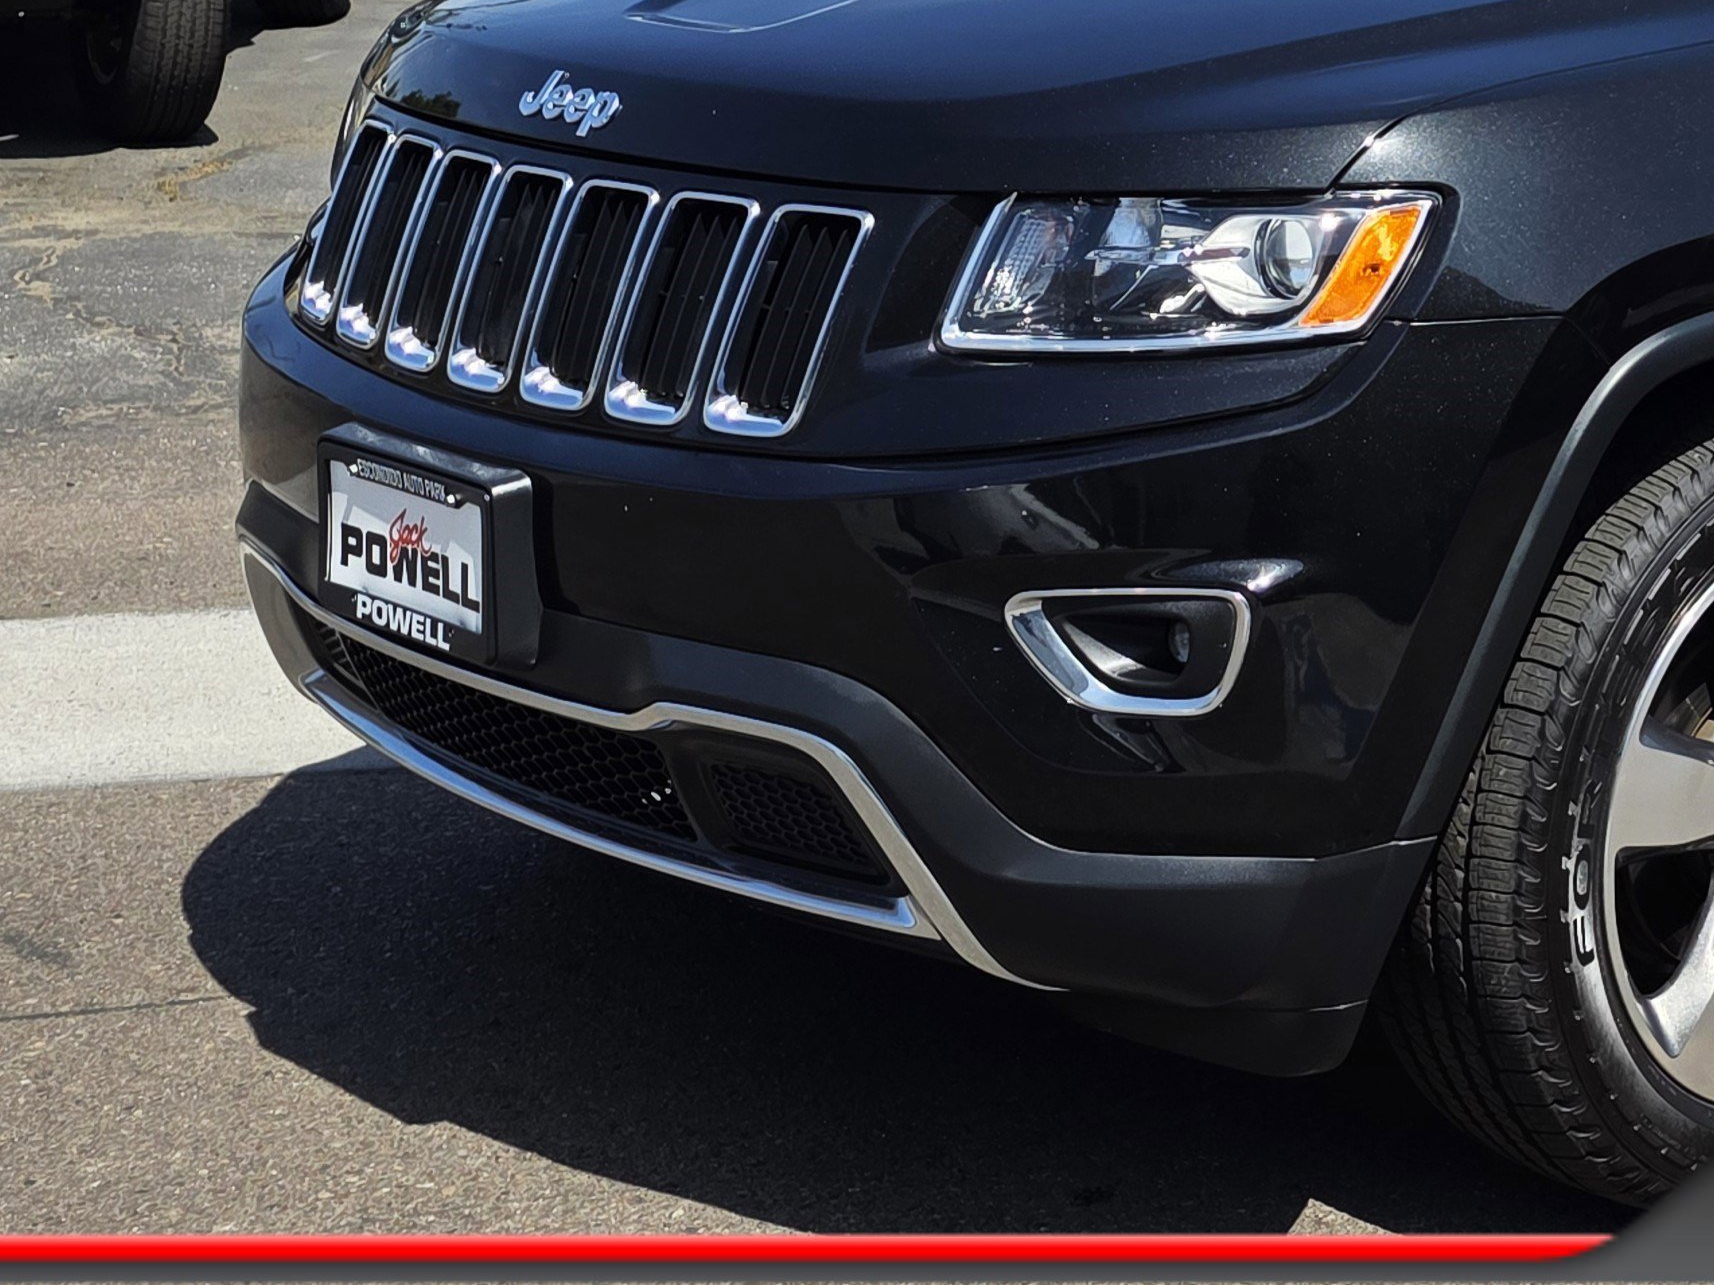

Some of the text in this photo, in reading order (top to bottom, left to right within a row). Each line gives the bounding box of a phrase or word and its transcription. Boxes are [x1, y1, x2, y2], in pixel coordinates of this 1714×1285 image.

[518, 69, 621, 138] Jeep
[402, 472, 424, 496] AUTO
[389, 508, 432, 563] Jack
[340, 521, 481, 614] POWELL
[356, 592, 450, 651] POWELL
